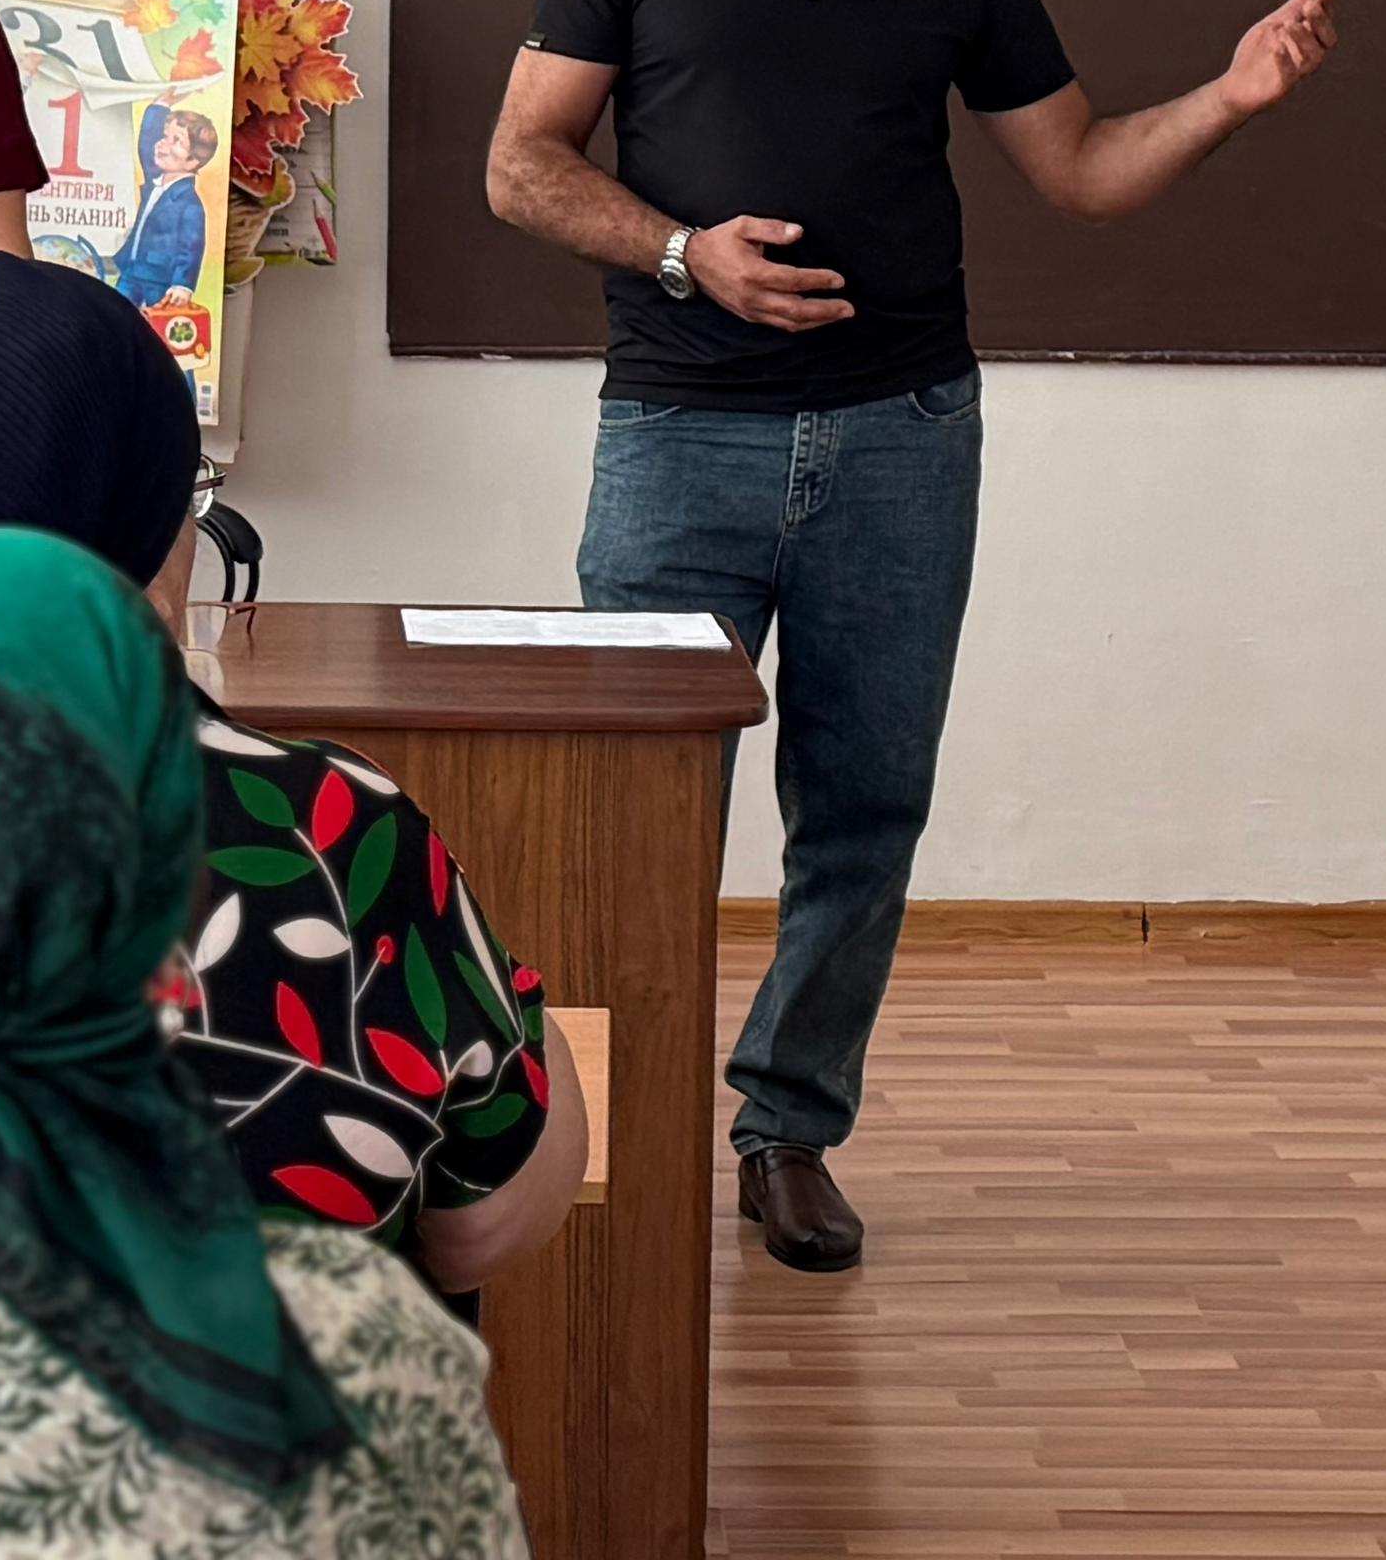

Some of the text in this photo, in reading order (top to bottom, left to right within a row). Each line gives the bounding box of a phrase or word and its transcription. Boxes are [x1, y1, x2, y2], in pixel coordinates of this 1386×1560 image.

[47, 90, 94, 179] 1
[40, 181, 114, 201] НТЯБРЯ
[28, 204, 126, 229] НЬ ЗНАНИЙ
